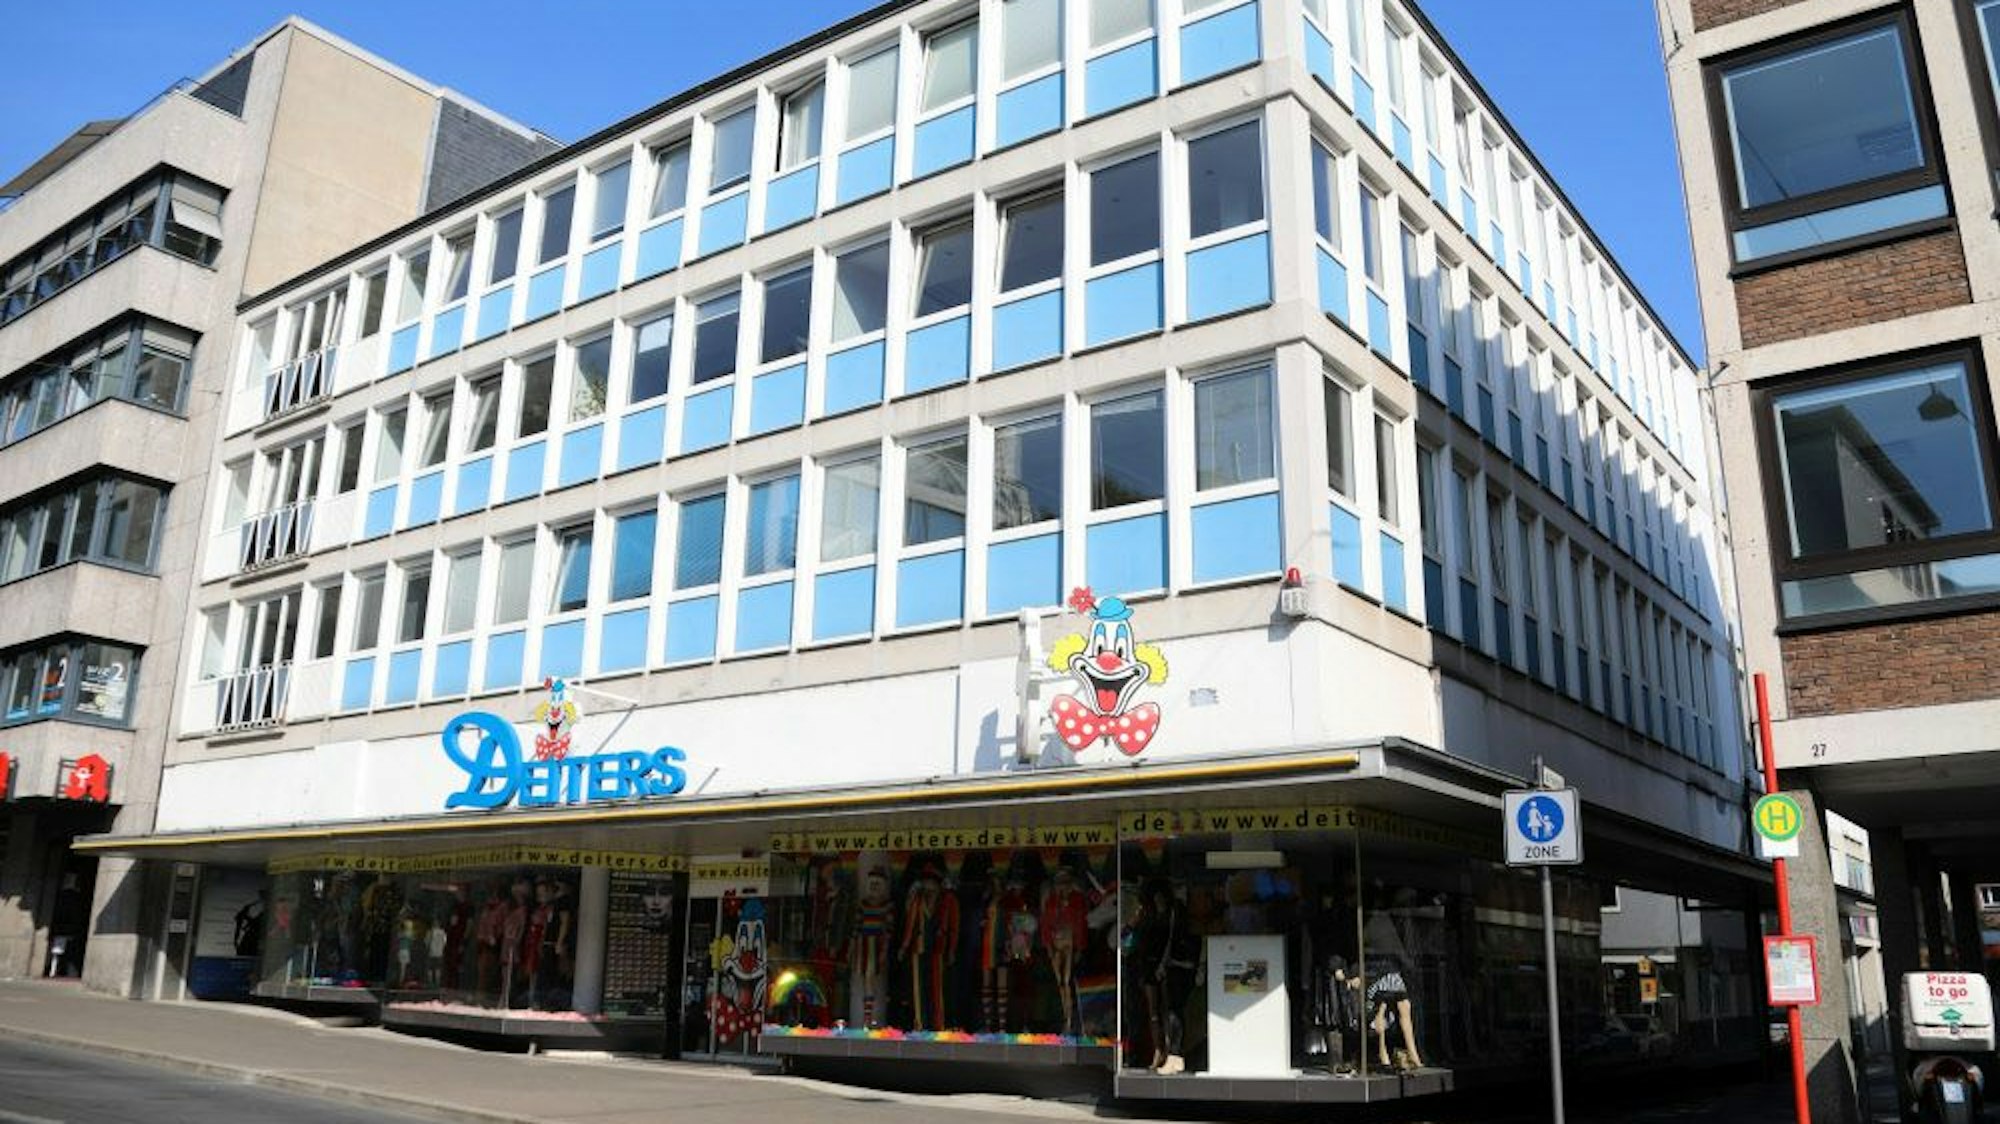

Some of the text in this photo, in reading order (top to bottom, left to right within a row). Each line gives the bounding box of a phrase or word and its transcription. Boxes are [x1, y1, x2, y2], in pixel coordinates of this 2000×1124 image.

[1811, 744, 1827, 757] 27
[1767, 805, 1788, 831] H
[1524, 845, 1560, 858] ZONE
[1926, 972, 1967, 985] Pizza
[1928, 986, 1968, 999] to go
